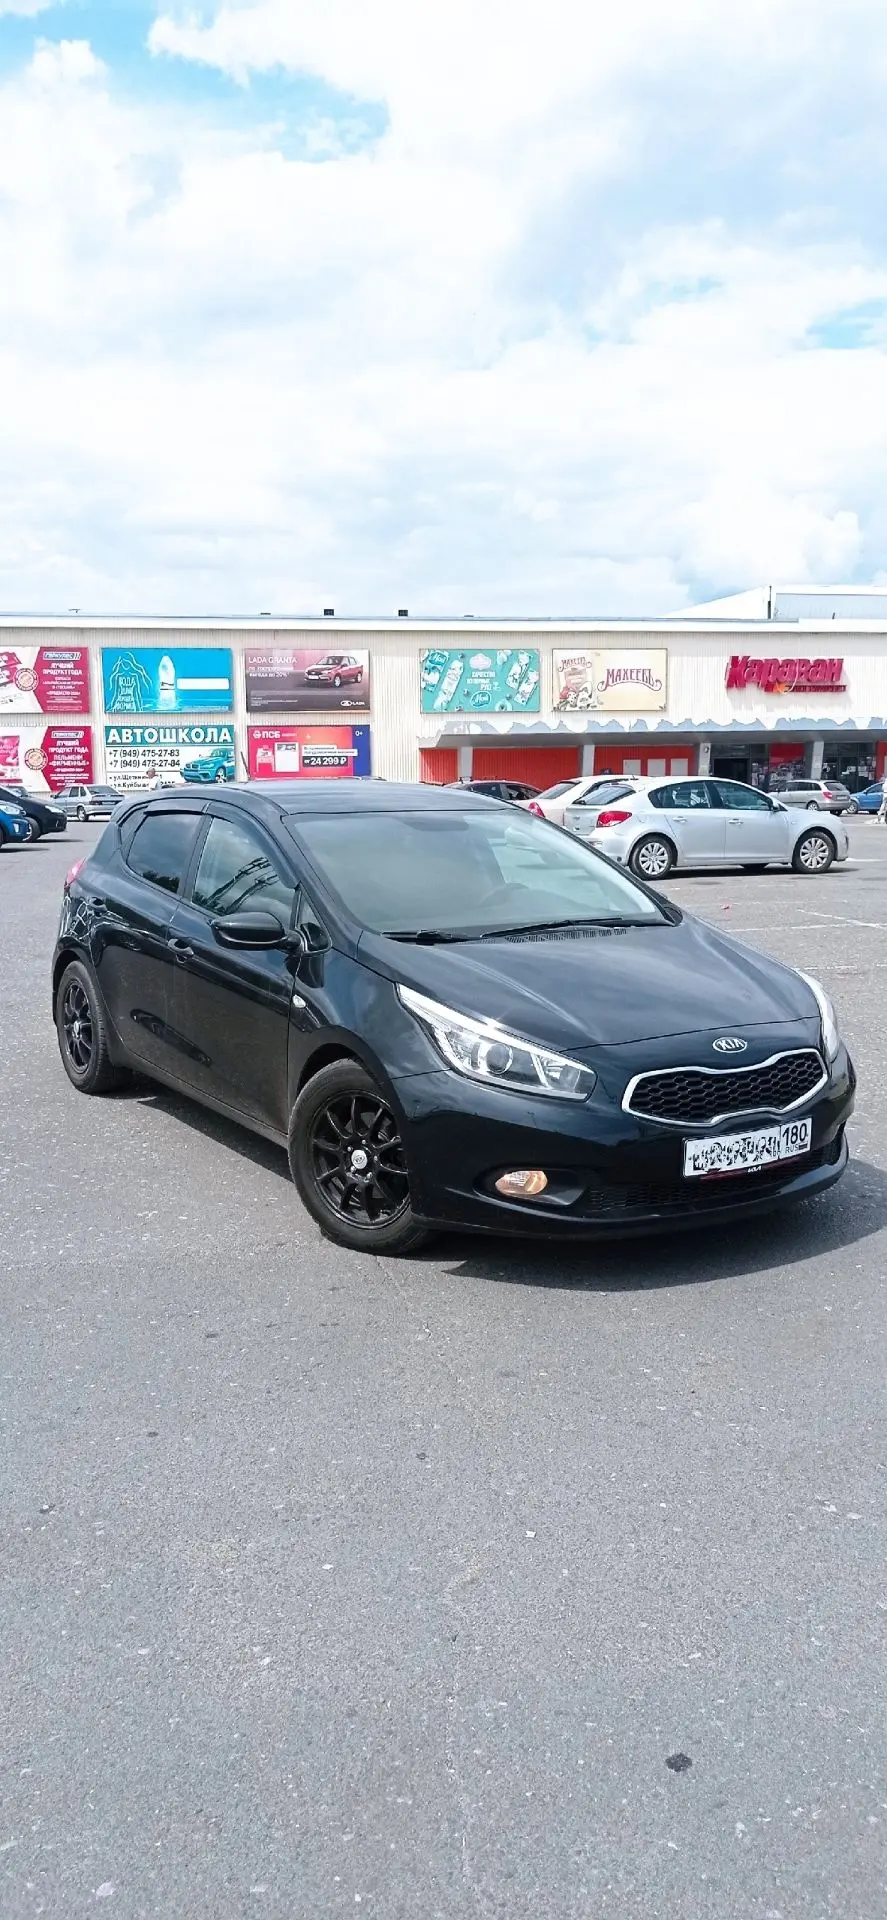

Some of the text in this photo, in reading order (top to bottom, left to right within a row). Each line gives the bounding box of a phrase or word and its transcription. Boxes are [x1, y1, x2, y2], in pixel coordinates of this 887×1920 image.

[726, 655, 844, 688] Караван
[107, 728, 232, 743] АВТОШКОЛА
[262, 730, 280, 738] ПСБ
[120, 749, 139, 758] (949)
[141, 749, 180, 757] 475-27-83
[120, 760, 140, 768] (949)
[311, 757, 321, 765] 24
[322, 757, 339, 765] 299
[716, 1038, 744, 1051] KIA
[782, 1122, 809, 1146] 180
[785, 1145, 799, 1154] RUS
